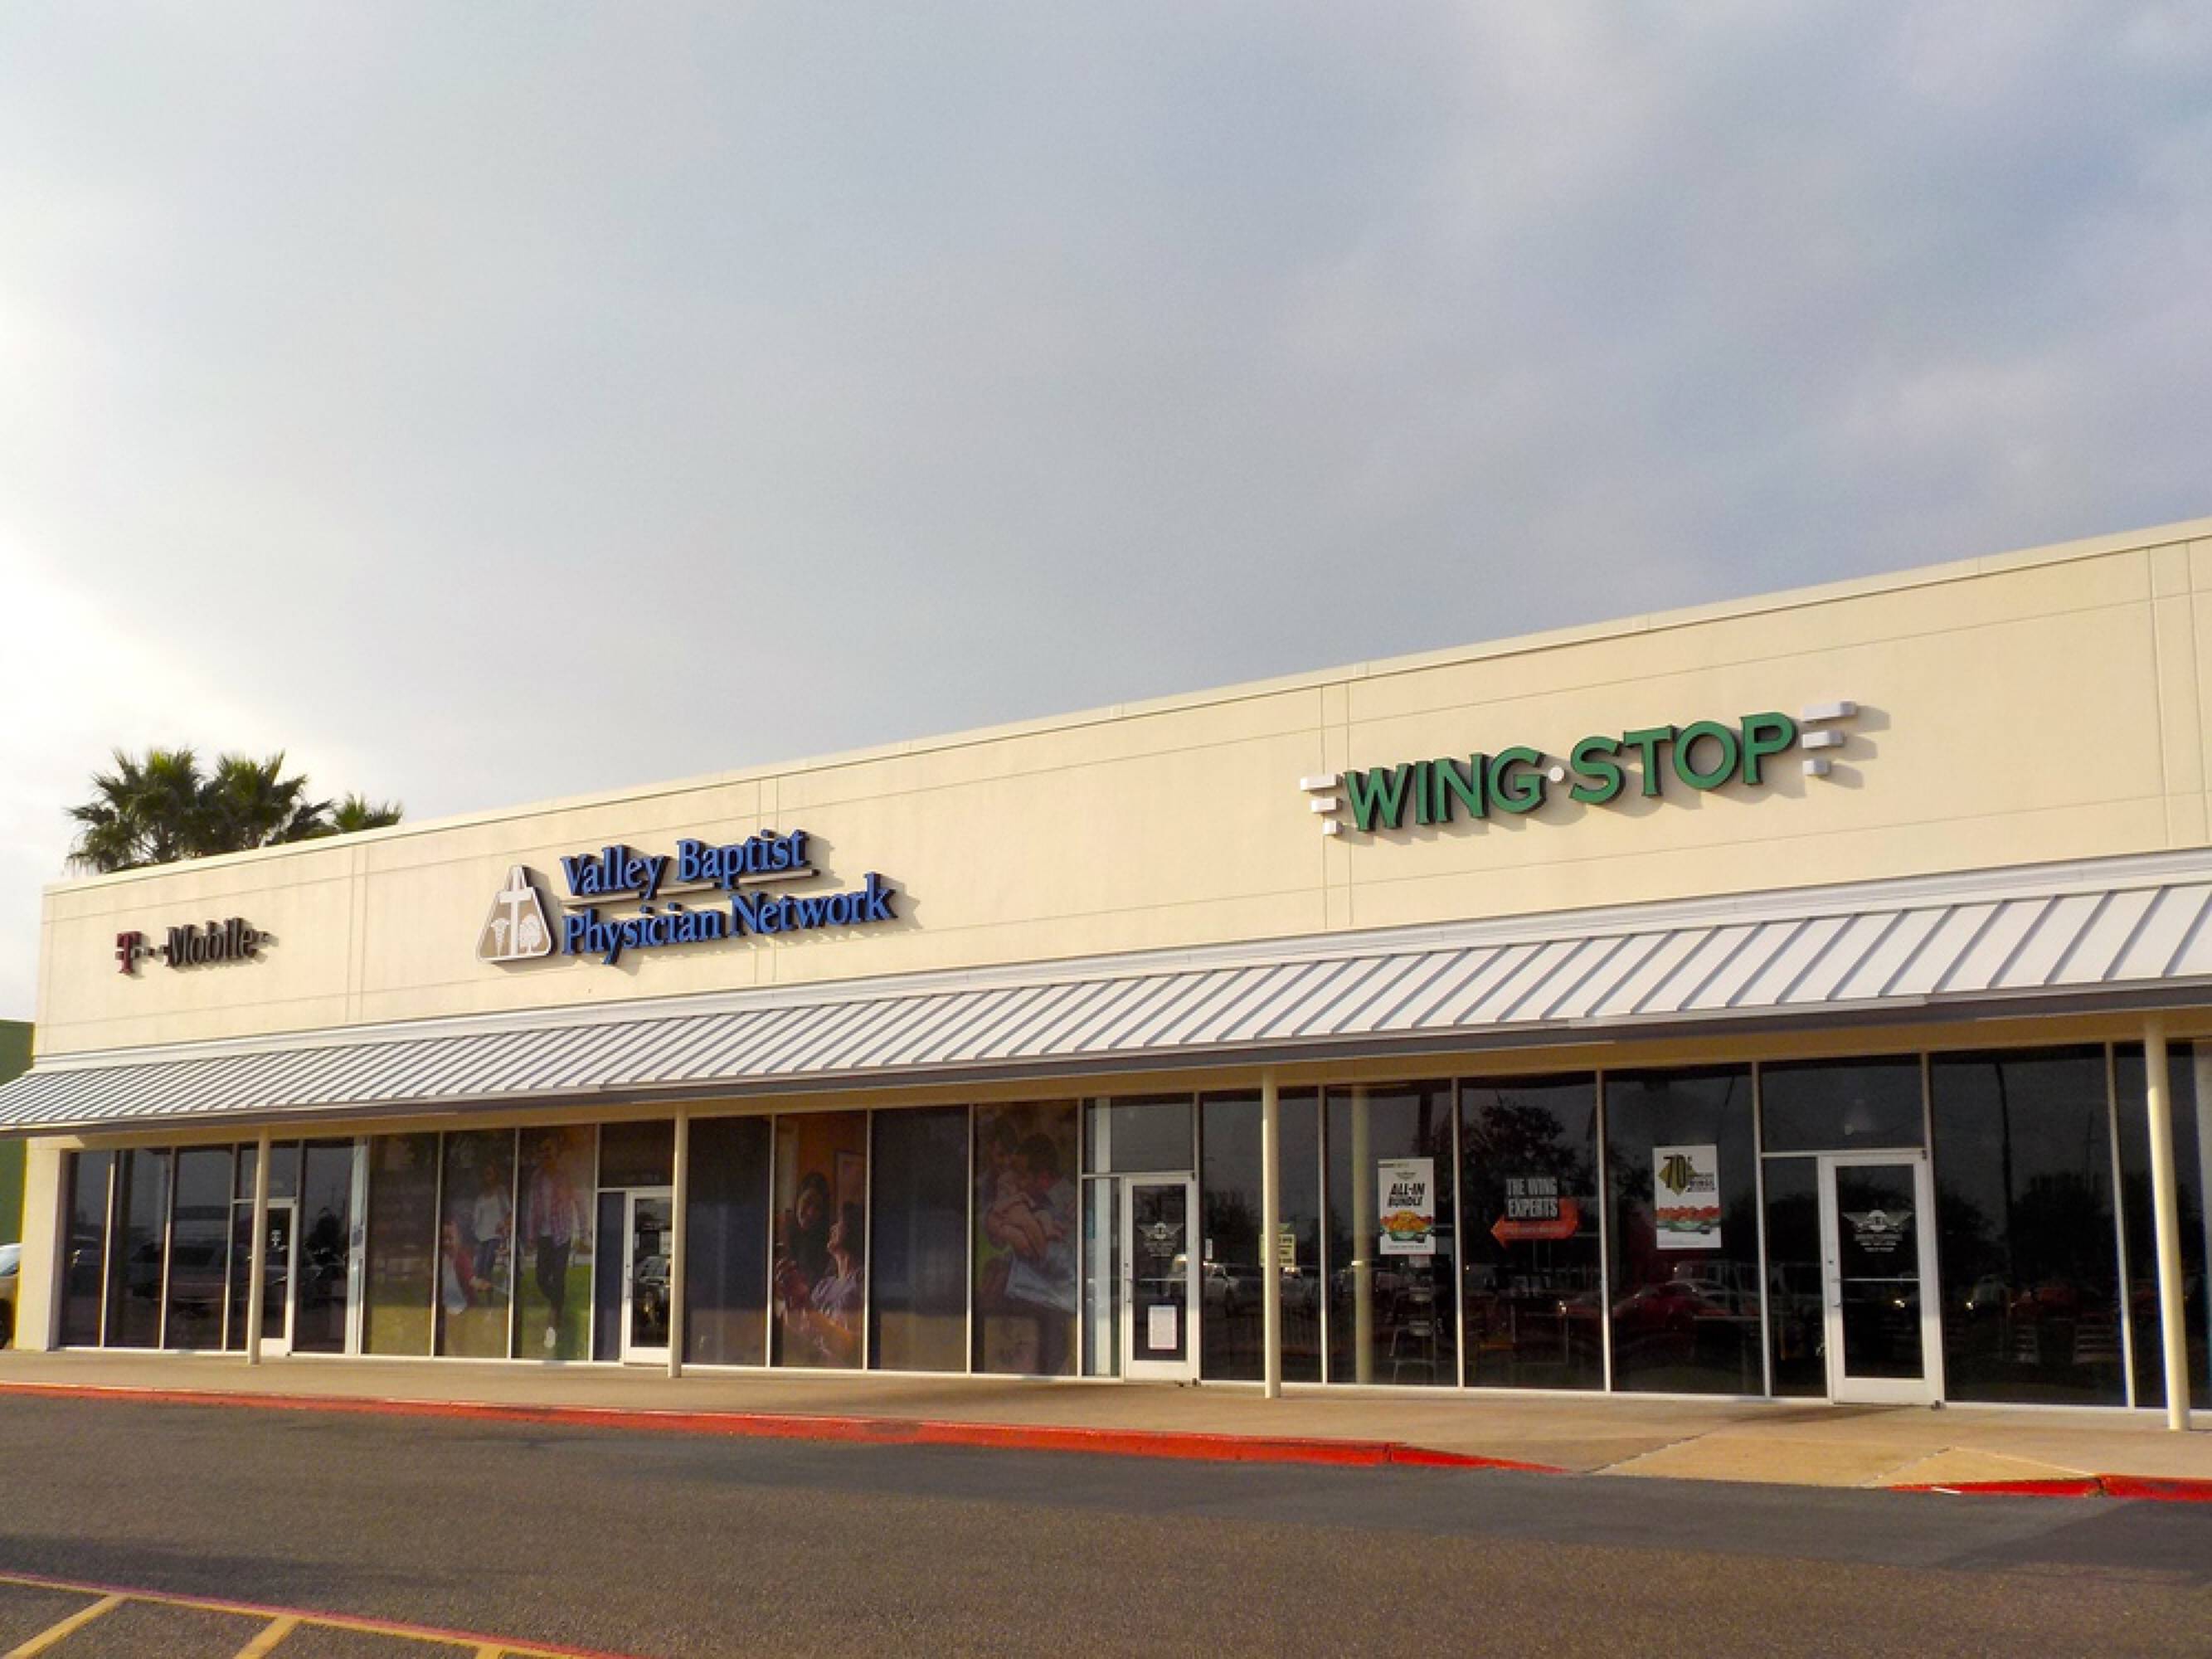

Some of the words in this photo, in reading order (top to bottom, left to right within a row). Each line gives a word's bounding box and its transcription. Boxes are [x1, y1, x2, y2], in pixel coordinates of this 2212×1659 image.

[560, 844, 668, 900] Valley
[677, 830, 810, 890] Baptist
[561, 902, 730, 965] Physician
[728, 872, 897, 938] Network
[1506, 1179, 1525, 1195] THE
[1528, 1177, 1558, 1195] WING
[1508, 1198, 1558, 1218] EXPERTS
